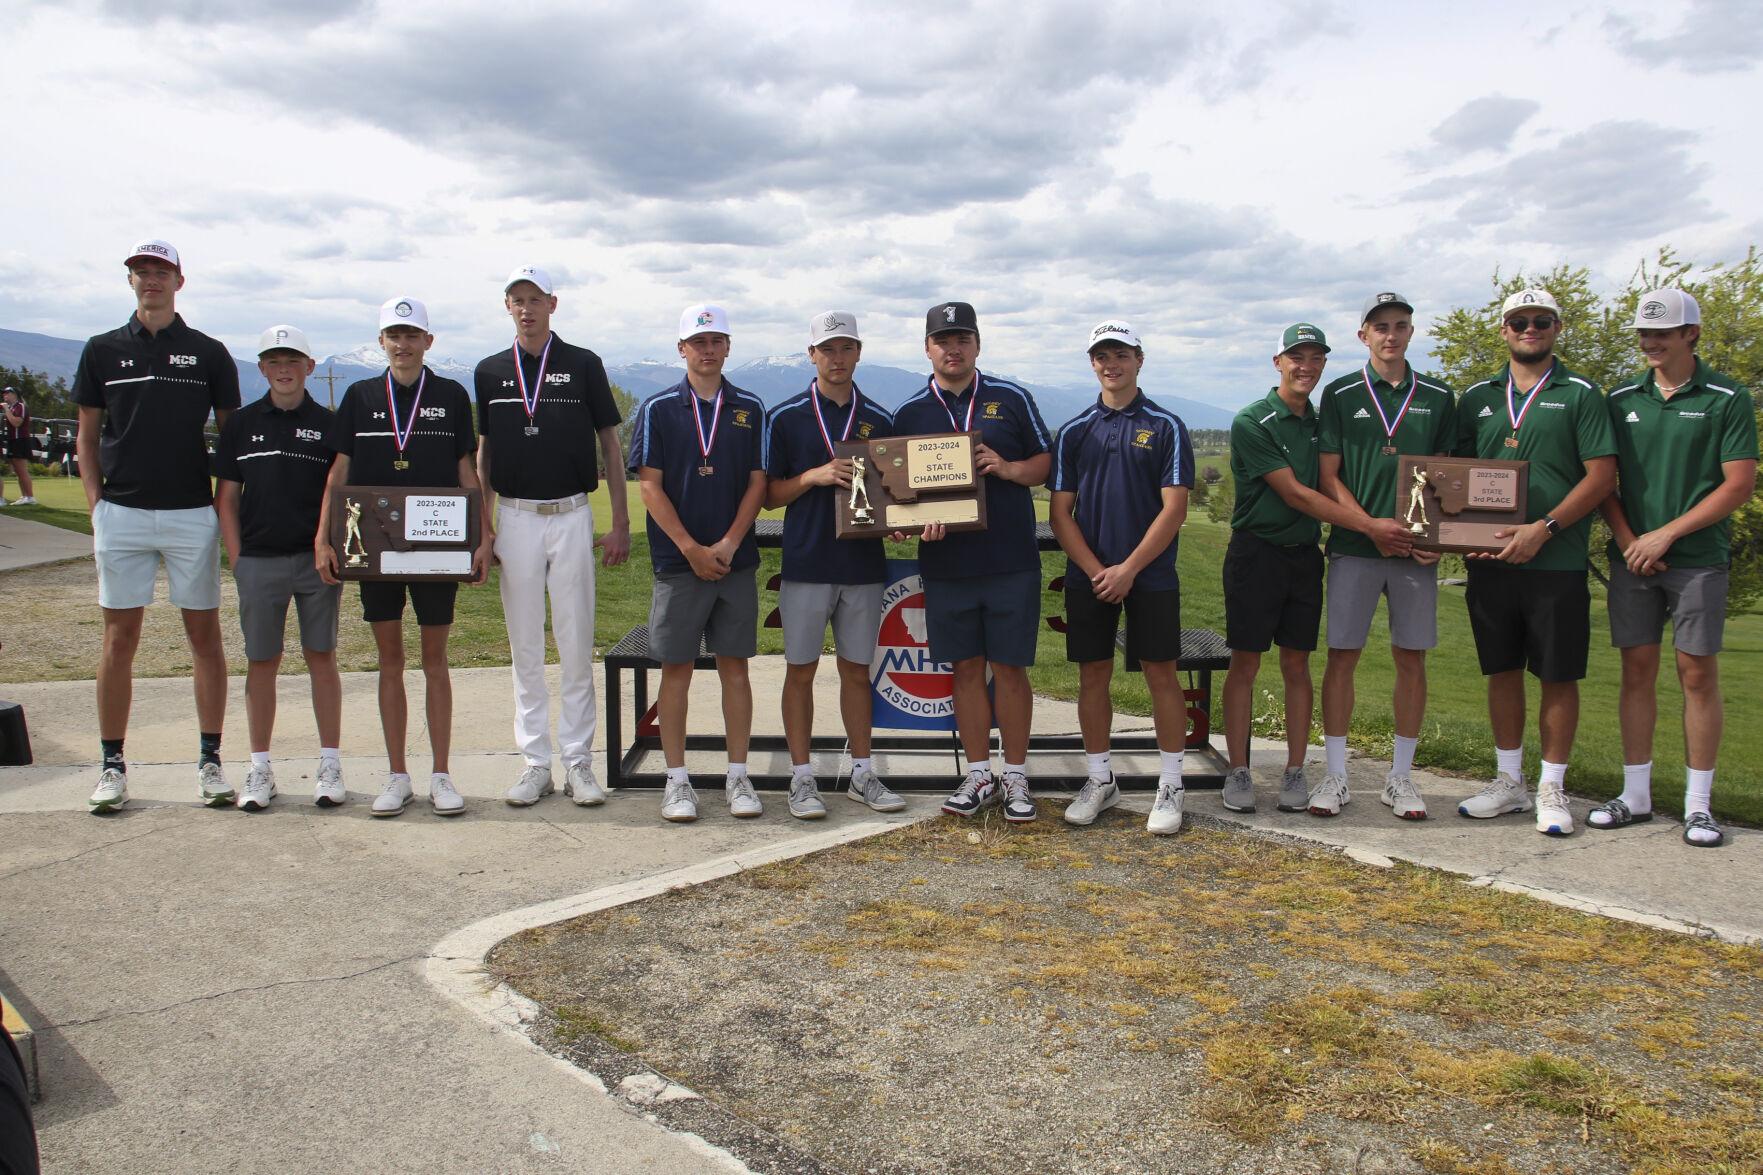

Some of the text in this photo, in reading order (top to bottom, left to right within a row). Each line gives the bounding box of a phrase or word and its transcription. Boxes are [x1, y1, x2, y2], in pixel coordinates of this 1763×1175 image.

[169, 354, 197, 365] MCS
[545, 373, 571, 383] MCS
[420, 407, 446, 418] MCS
[295, 428, 322, 440] MCS
[918, 441, 960, 451] 2023-2024
[936, 453, 942, 461] C
[926, 462, 954, 472] STATE
[913, 472, 968, 484] CHAMPIONS
[1476, 471, 1509, 479] 2023-2024
[416, 500, 456, 508] 2023-2024
[423, 519, 449, 527] STATE
[430, 529, 460, 537] PLACE
[880, 584, 910, 613] ANA
[882, 686, 955, 715] ASSOCIAT
